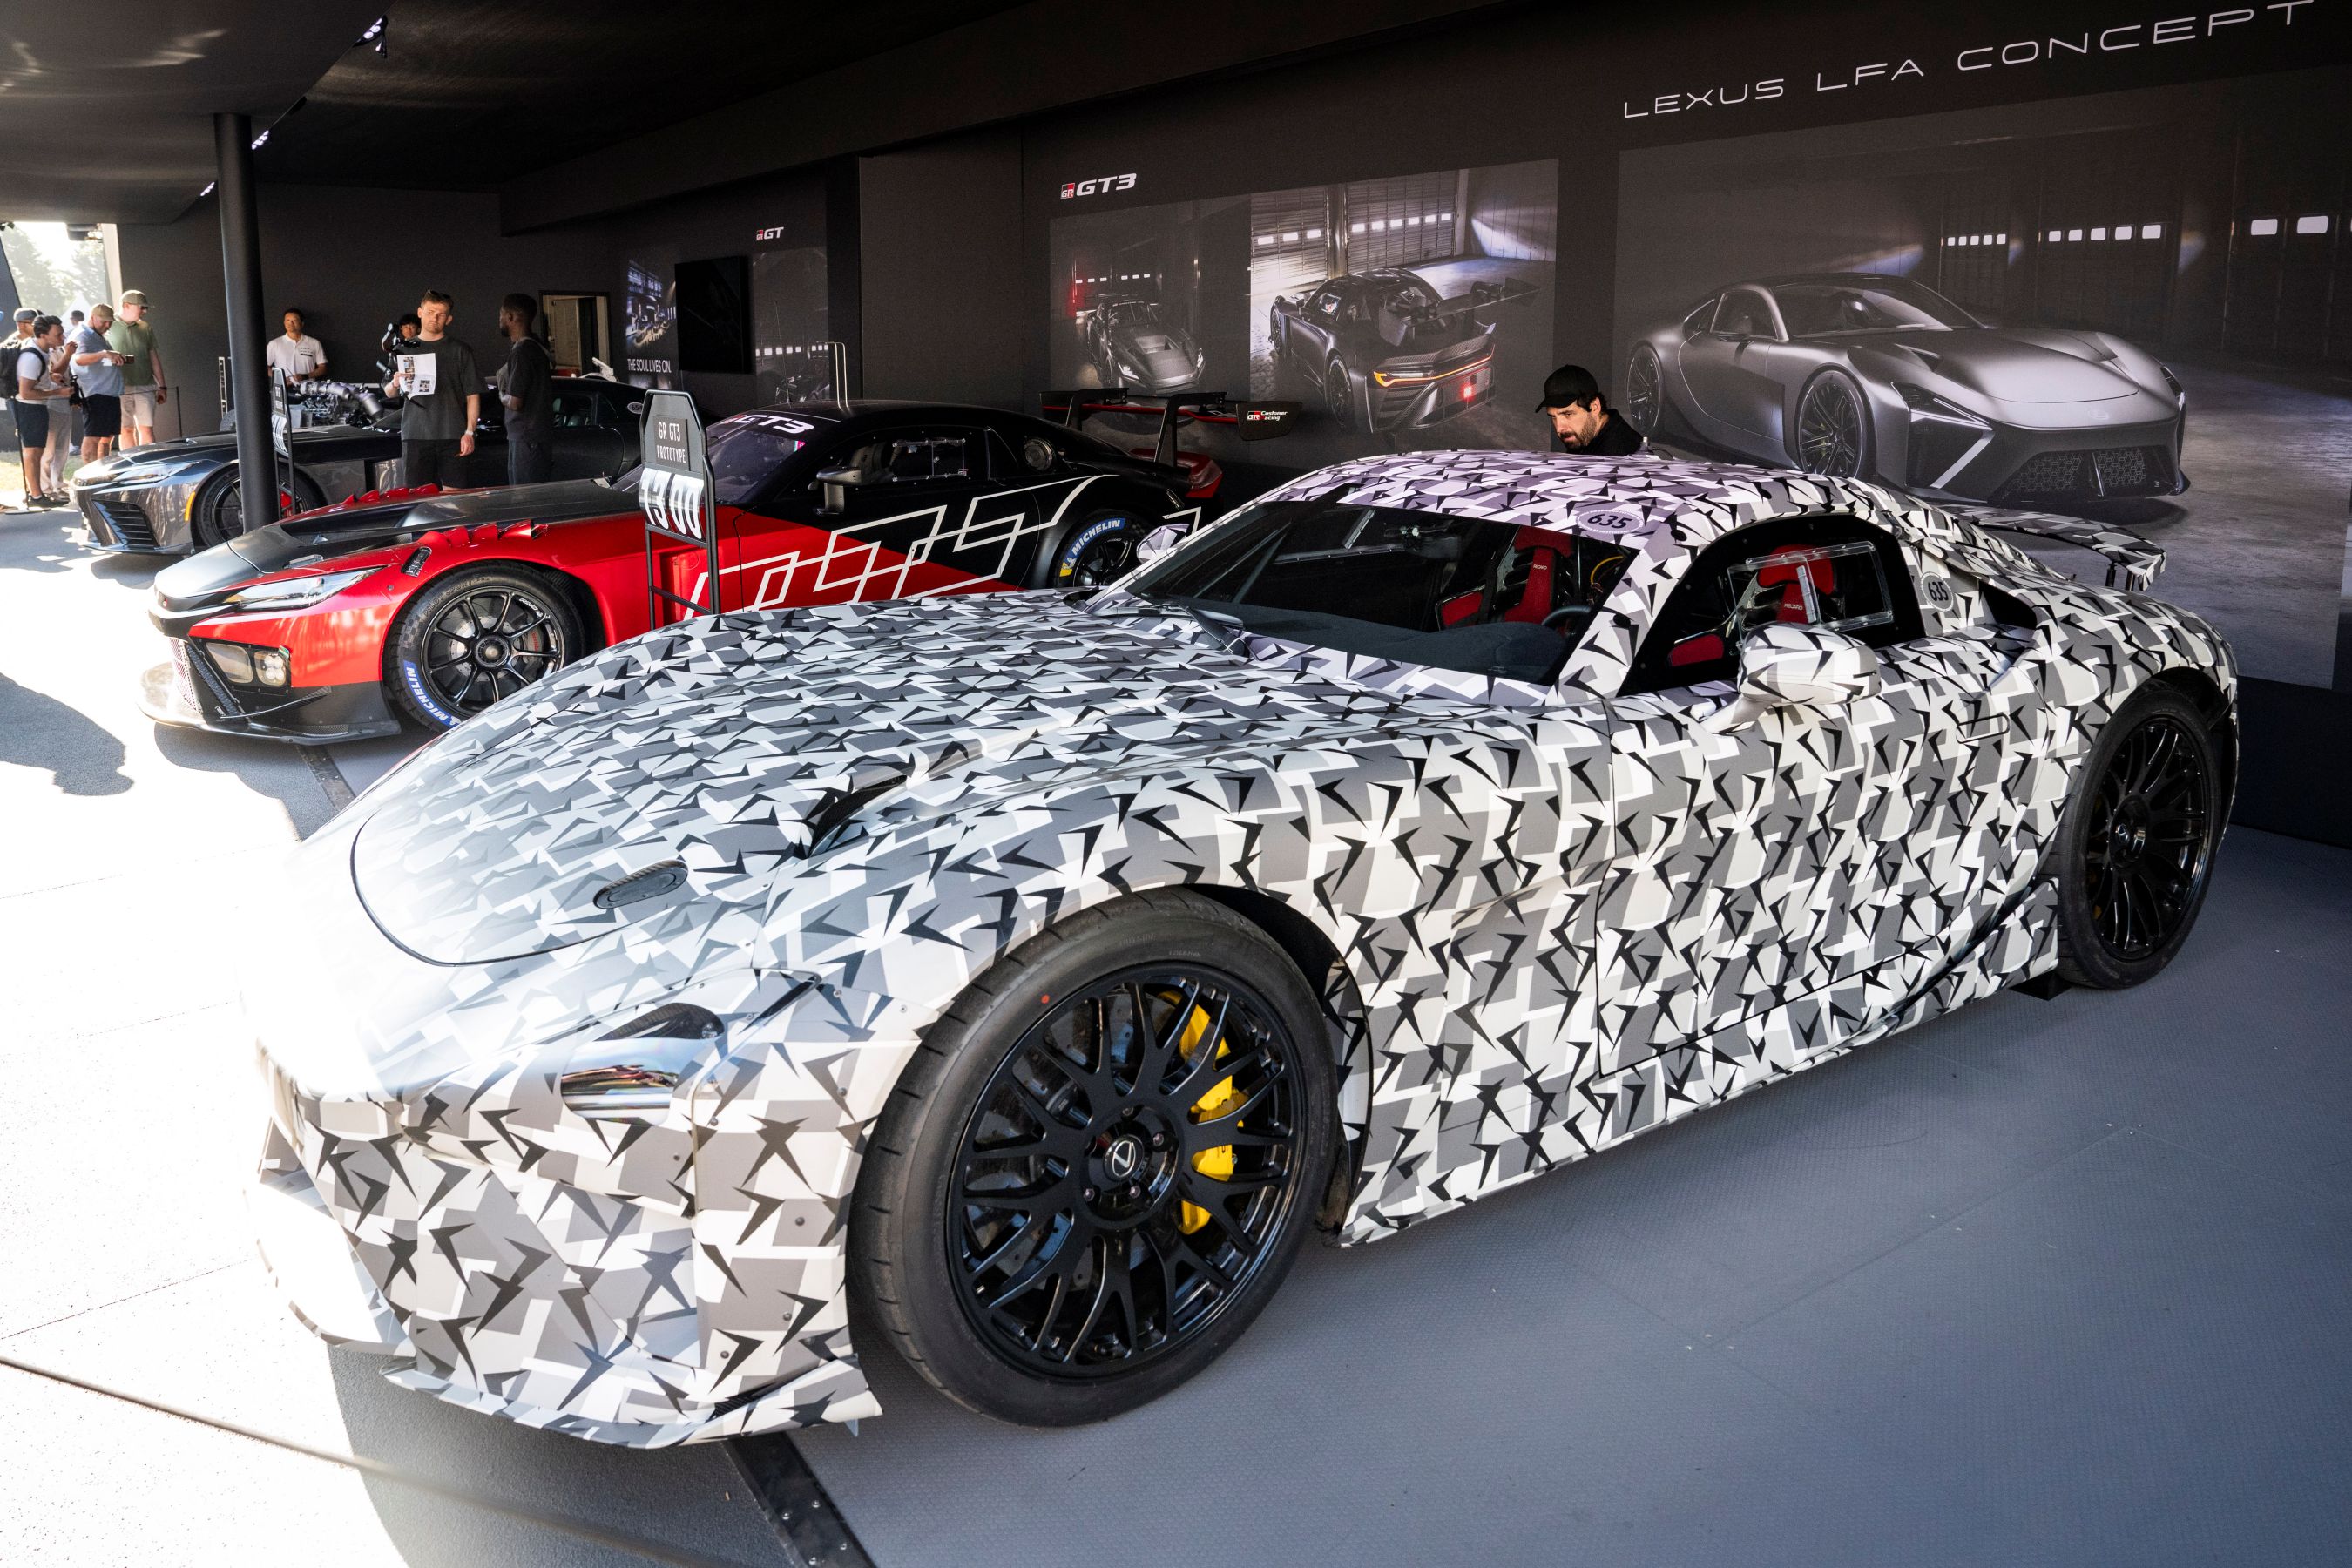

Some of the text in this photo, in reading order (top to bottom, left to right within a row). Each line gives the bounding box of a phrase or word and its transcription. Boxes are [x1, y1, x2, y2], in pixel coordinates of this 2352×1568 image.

[1624, 0, 2315, 118] LEXUS LFA CONCEPT
[1076, 172, 1138, 197] GT3
[763, 226, 785, 240] GT
[627, 358, 636, 371] THE
[637, 358, 649, 372] SOUL
[649, 359, 661, 373] LIVES
[732, 414, 815, 434] GT3
[1247, 412, 1260, 421] GR
[658, 421, 681, 443] GR GT3
[656, 444, 686, 463] PROTOTYPE
[1587, 513, 1633, 529] 635
[1071, 519, 1121, 556] MICHELIN
[1927, 581, 1949, 602] 635
[406, 666, 449, 722] MICHELIN
